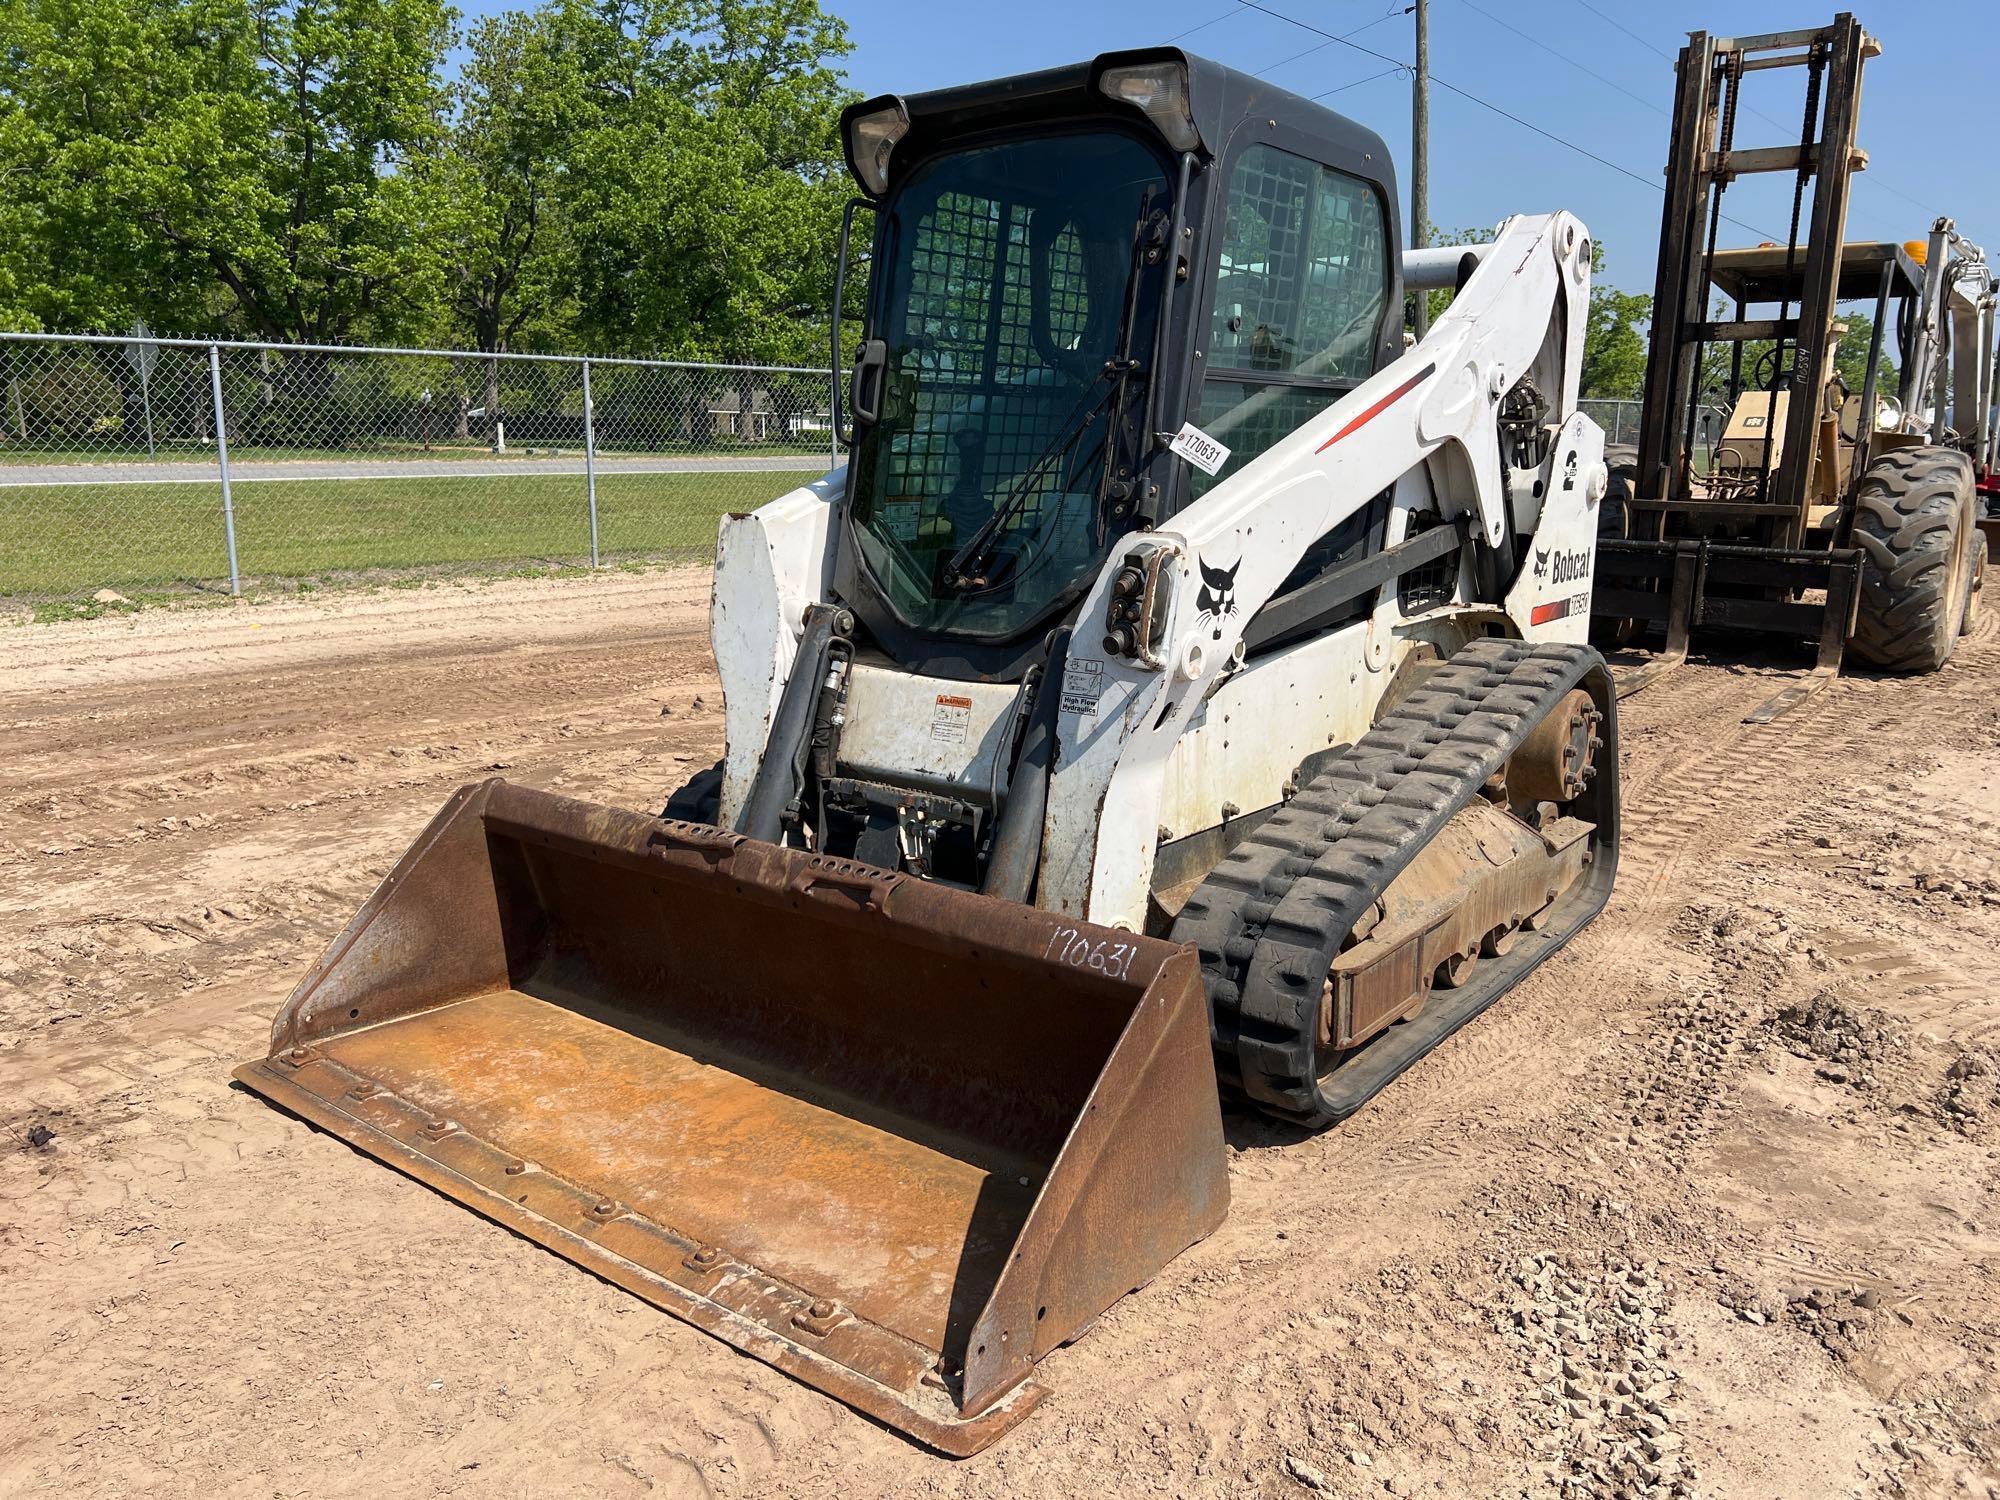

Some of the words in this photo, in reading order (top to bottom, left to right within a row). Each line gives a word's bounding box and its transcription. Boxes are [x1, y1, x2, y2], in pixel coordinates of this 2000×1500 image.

[1185, 434, 1221, 463] 170631
[1552, 546, 1591, 585] Bobcat
[944, 698, 969, 707] WARNING
[1062, 704, 1096, 713] Hydraulics
[1064, 697, 1079, 705] High
[1080, 698, 1097, 706] Flow
[1043, 926, 1137, 981] 170631
